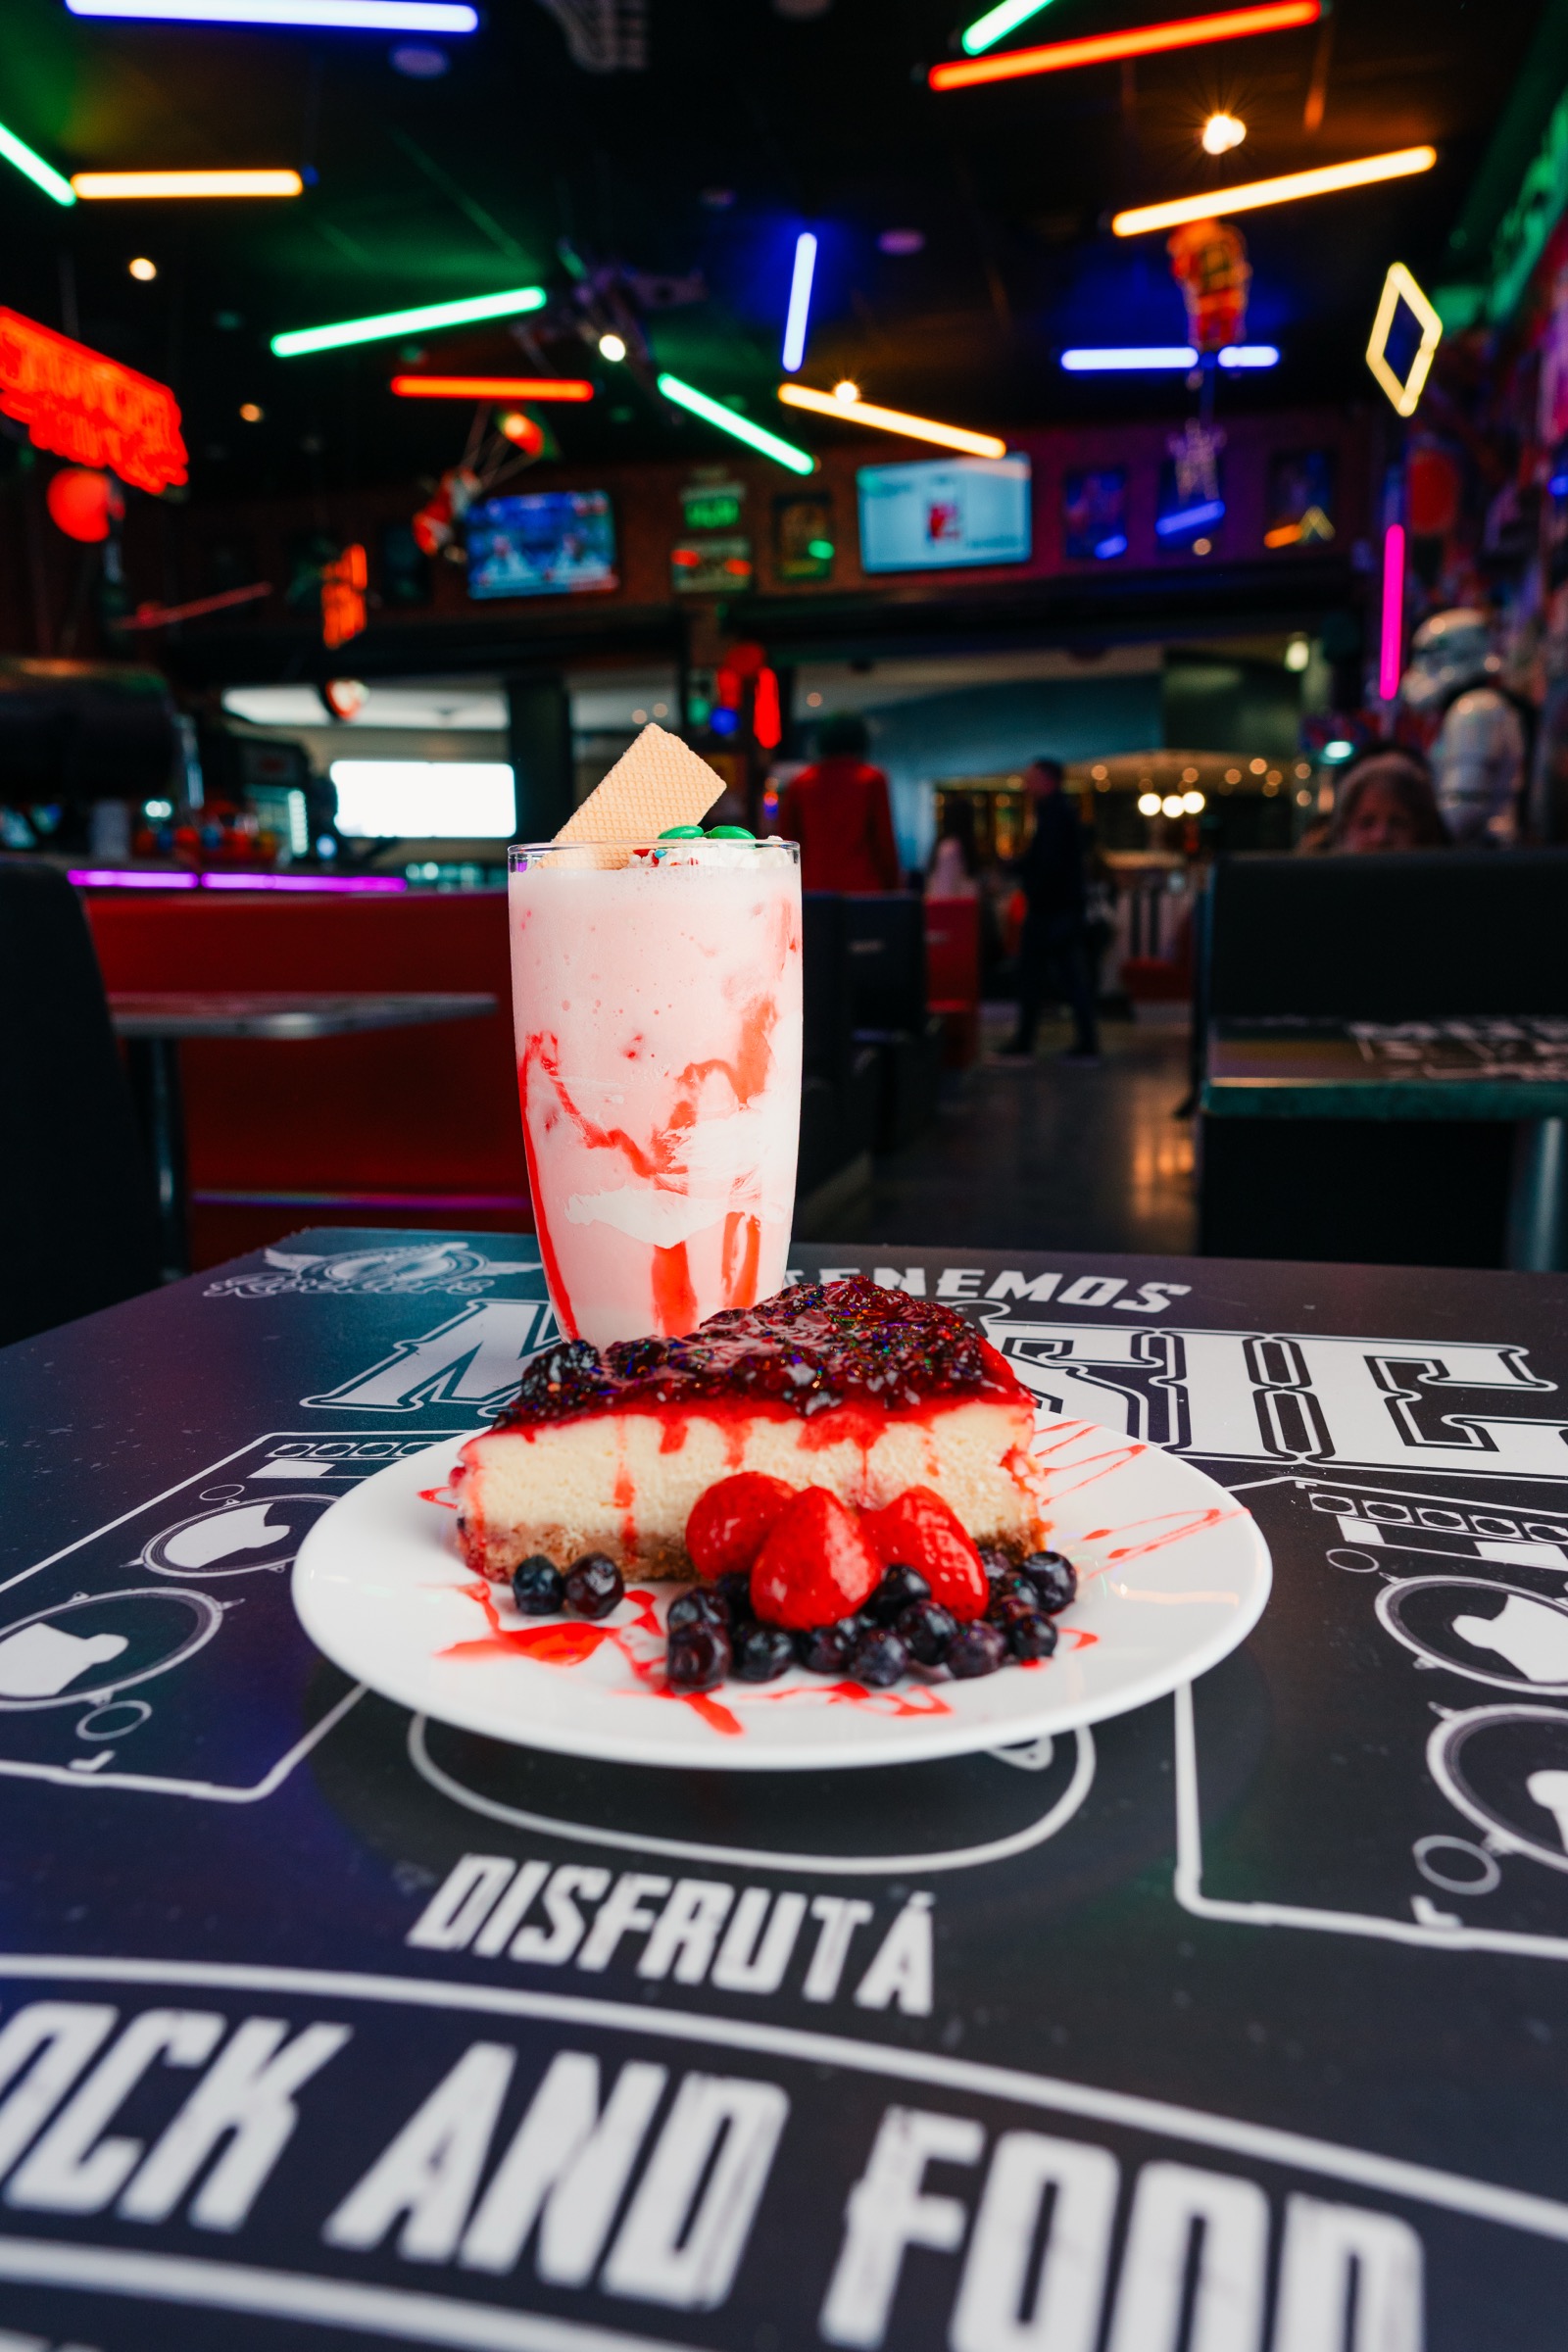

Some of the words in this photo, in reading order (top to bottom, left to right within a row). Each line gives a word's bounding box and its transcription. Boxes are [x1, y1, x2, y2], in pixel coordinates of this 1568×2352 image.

[785, 1266, 1193, 1313] NEMOS
[406, 1852, 934, 2016] DISFRUTÁ
[321, 2040, 790, 2312] AND
[818, 2103, 1427, 2352] FOOD
